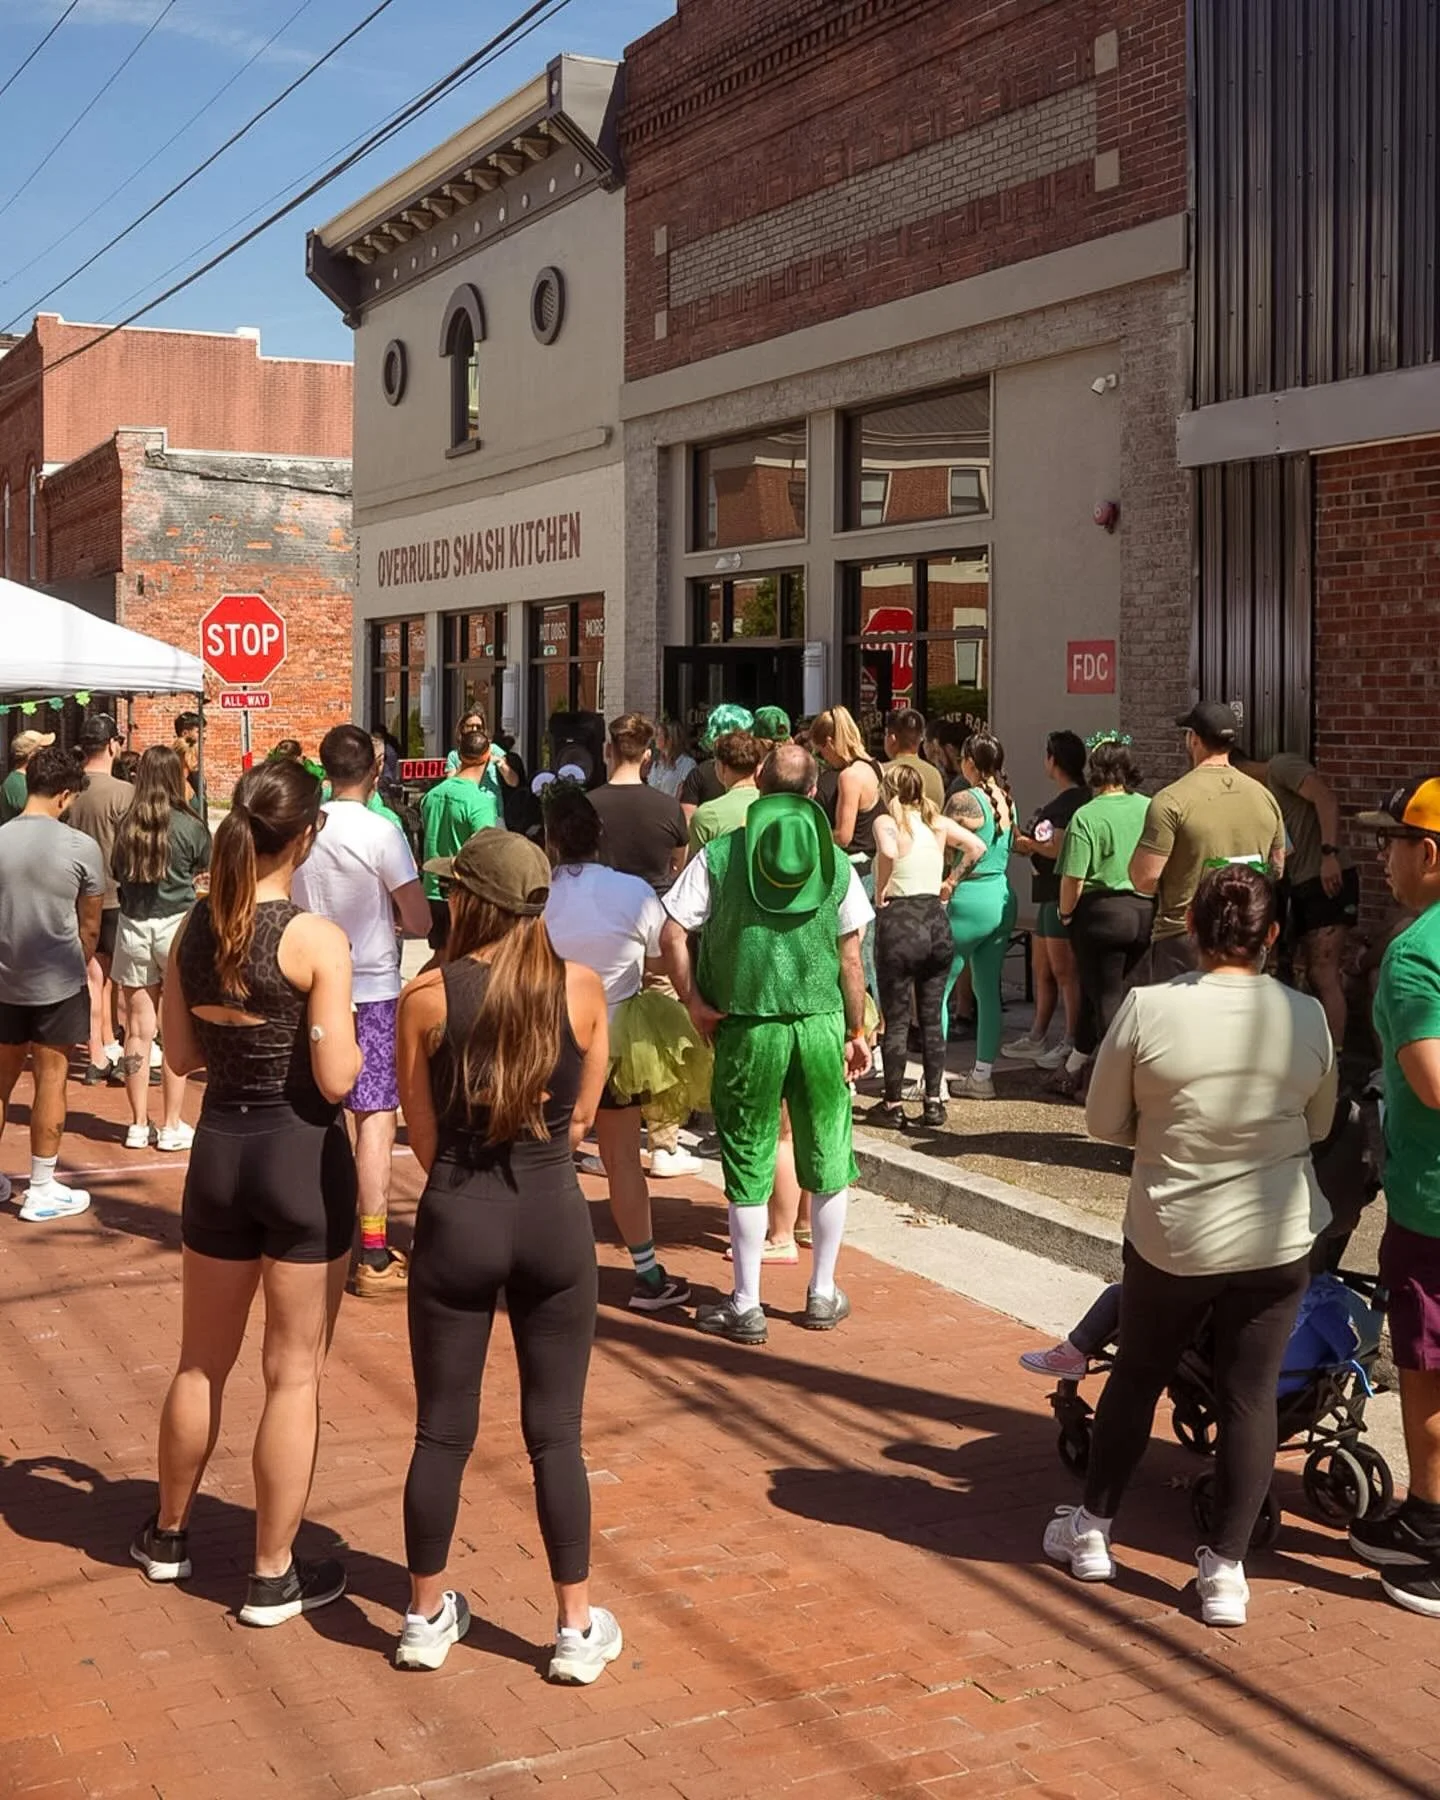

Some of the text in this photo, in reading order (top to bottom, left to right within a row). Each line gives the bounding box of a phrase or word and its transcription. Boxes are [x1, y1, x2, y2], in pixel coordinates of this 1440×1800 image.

[377, 511, 581, 588] OVERRULED SMASH KITCHEN
[207, 623, 280, 657] STOP
[1072, 653, 1108, 681] FDC
[224, 695, 267, 706] ALL WAY
